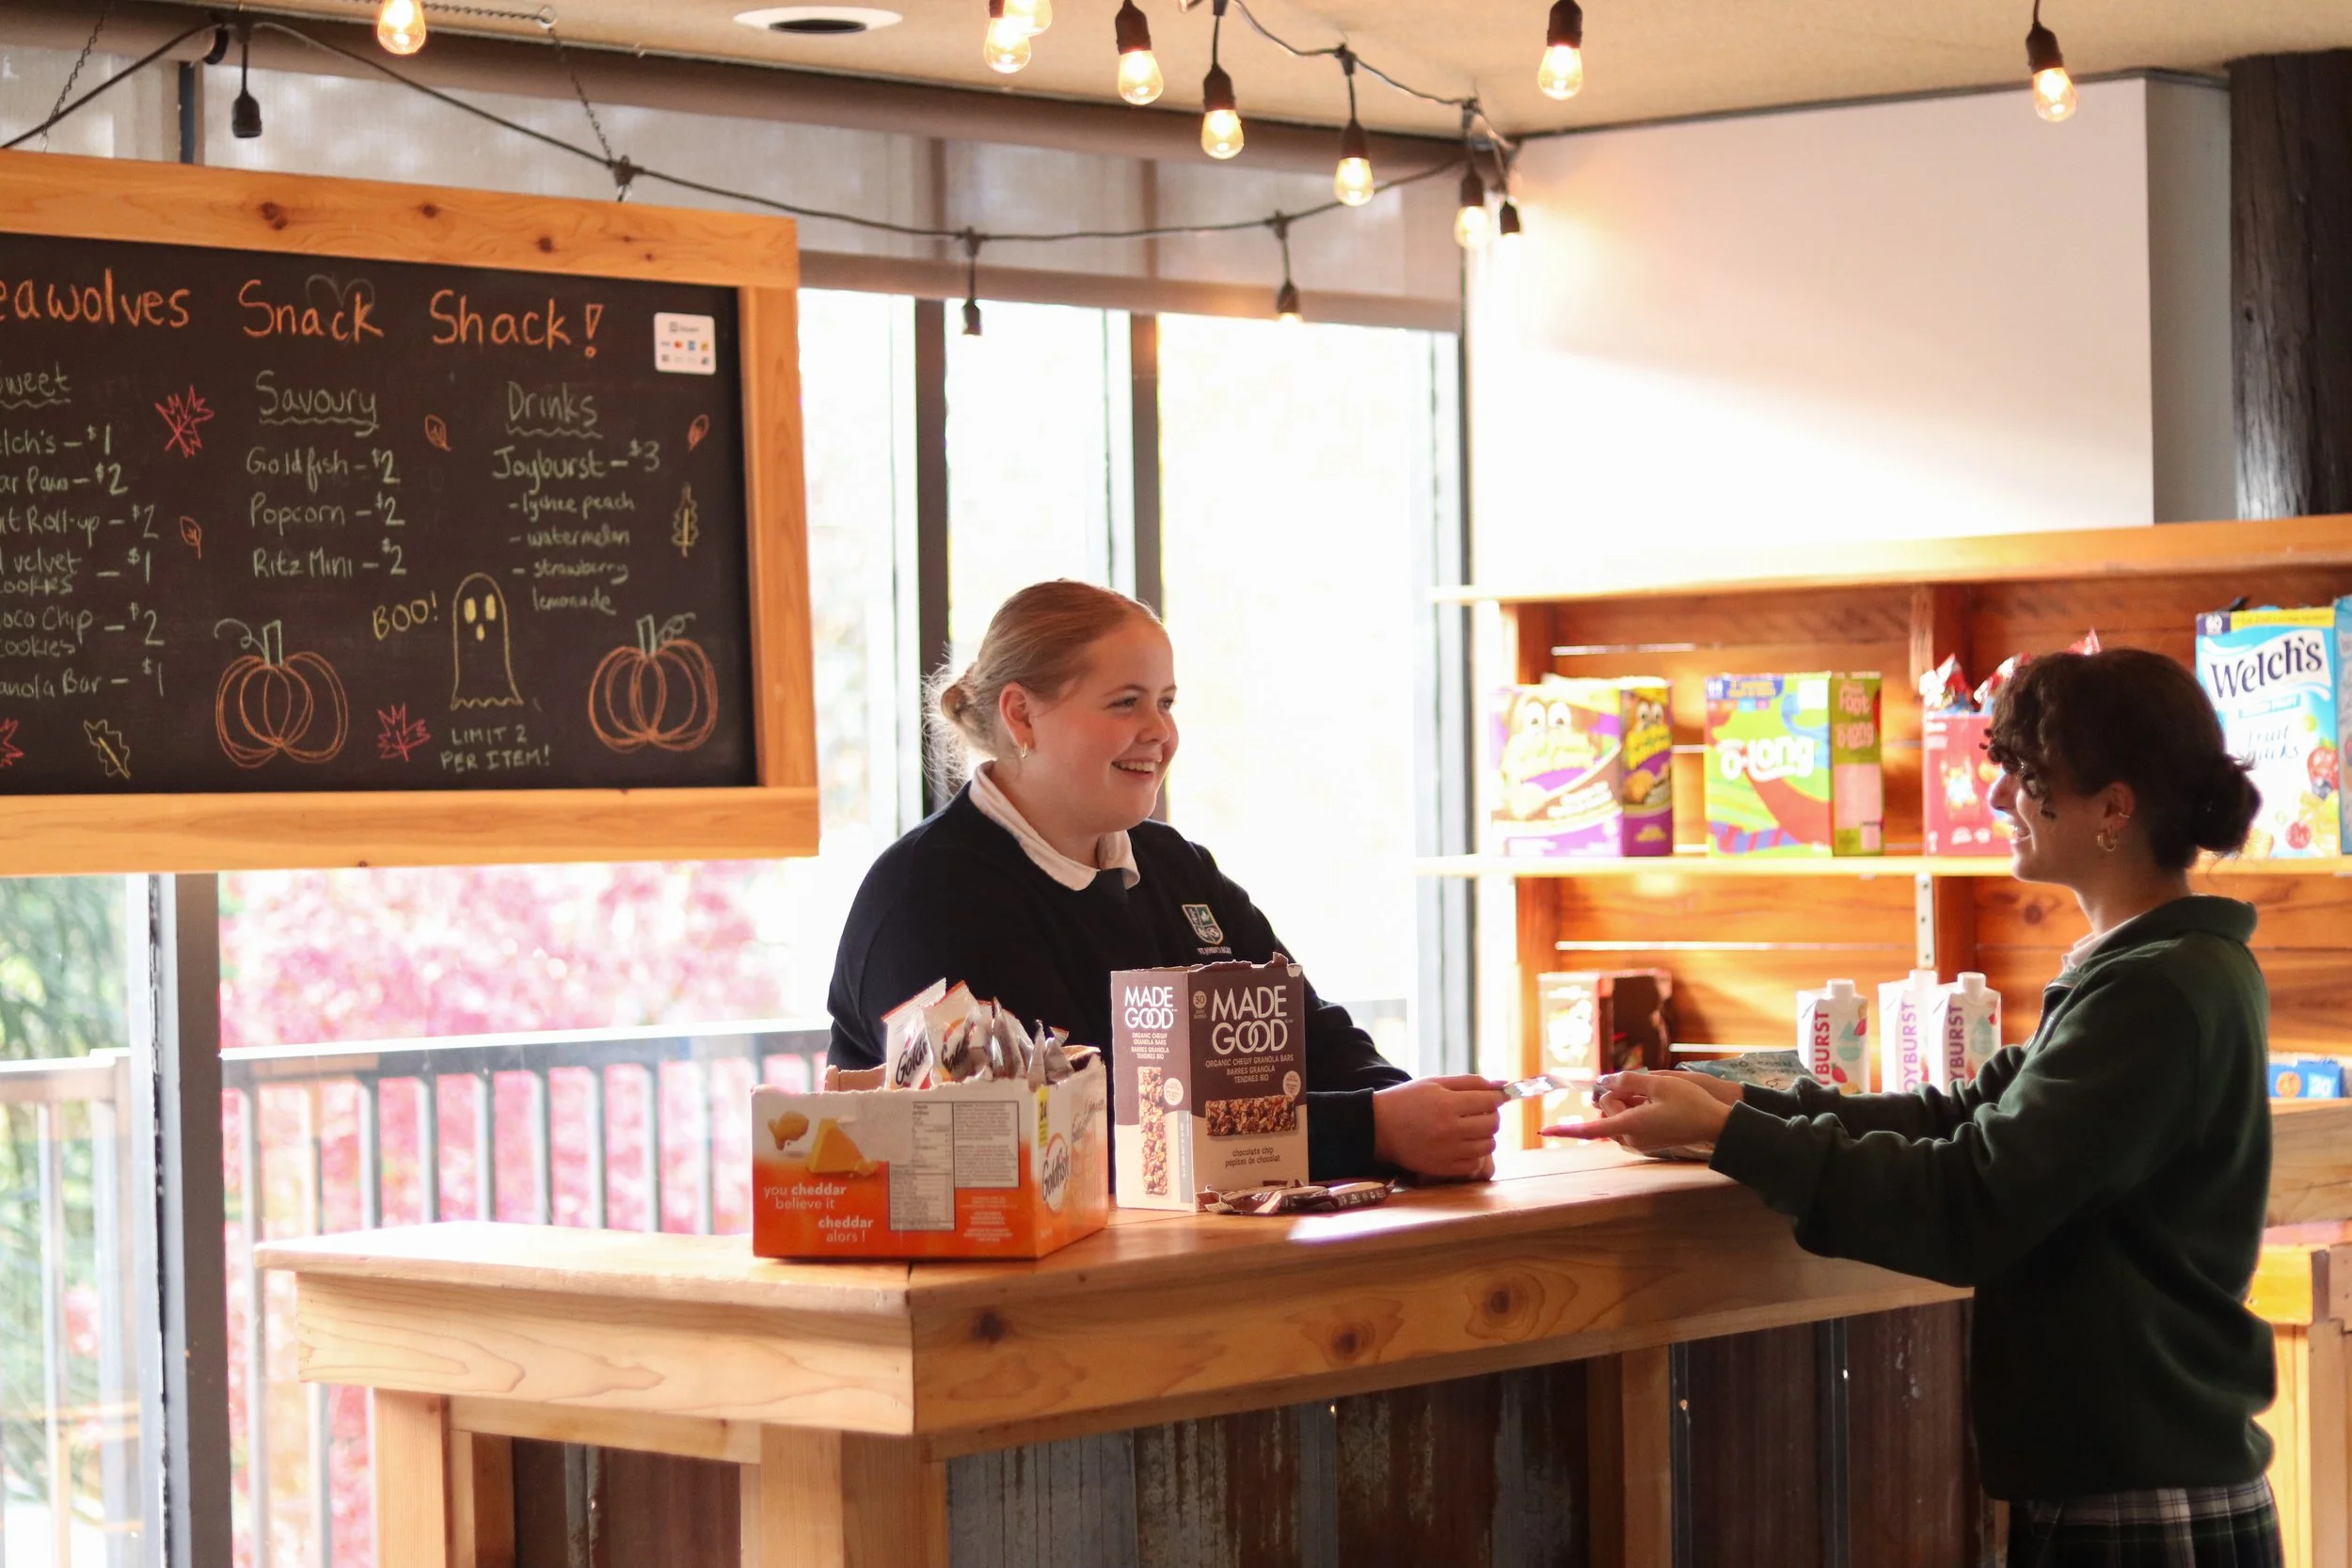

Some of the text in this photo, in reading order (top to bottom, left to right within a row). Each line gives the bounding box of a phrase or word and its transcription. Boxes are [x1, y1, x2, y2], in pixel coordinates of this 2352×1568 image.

[238, 279, 385, 342] Snack
[0, 360, 72, 398] weet
[256, 370, 379, 438] Savoury
[508, 381, 598, 428] Drinks
[0, 428, 56, 457] lch's
[87, 424, 111, 455] $1
[95, 462, 129, 496] $2
[246, 447, 348, 494] Goldfish
[372, 447, 401, 483] $2
[492, 445, 606, 496] Joyburst
[628, 438, 660, 472] $3
[132, 503, 159, 539] $2
[250, 492, 345, 536] Popcorn
[376, 491, 405, 526] $2
[582, 490, 636, 520] peach
[527, 523, 630, 547] watermelon
[128, 546, 151, 584] $1
[253, 547, 304, 578] Ritz
[310, 546, 352, 578] Mini
[382, 537, 407, 575] $2
[373, 591, 438, 641] BOO!
[532, 585, 617, 616] lemonade
[42, 605, 93, 644] Chip
[130, 602, 165, 646] $2
[62, 667, 102, 696] Bar
[142, 657, 164, 697] $1
[2211, 636, 2322, 698] Welch's
[452, 723, 527, 746] LIMIT 2
[439, 743, 550, 774] PER ITEM!
[1124, 986, 1173, 1007] MADE
[1211, 985, 1287, 1022] MADE
[1124, 1007, 1174, 1029] GOOD
[1212, 1019, 1288, 1054] GOOD
[1205, 1053, 1295, 1068] ORGANIC CHEWY GRANOLA BARS
[1226, 1065, 1276, 1076] BARRES GRANOLA
[1233, 1073, 1269, 1084] TENDRES BIO
[1232, 1146, 1274, 1157] chocolate chip
[1256, 1154, 1280, 1164] chocolat
[764, 1182, 847, 1200] you cheddar
[1041, 1146, 1070, 1205] Goldfish
[775, 1196, 835, 1210] believe it
[818, 1215, 873, 1228] cheddar
